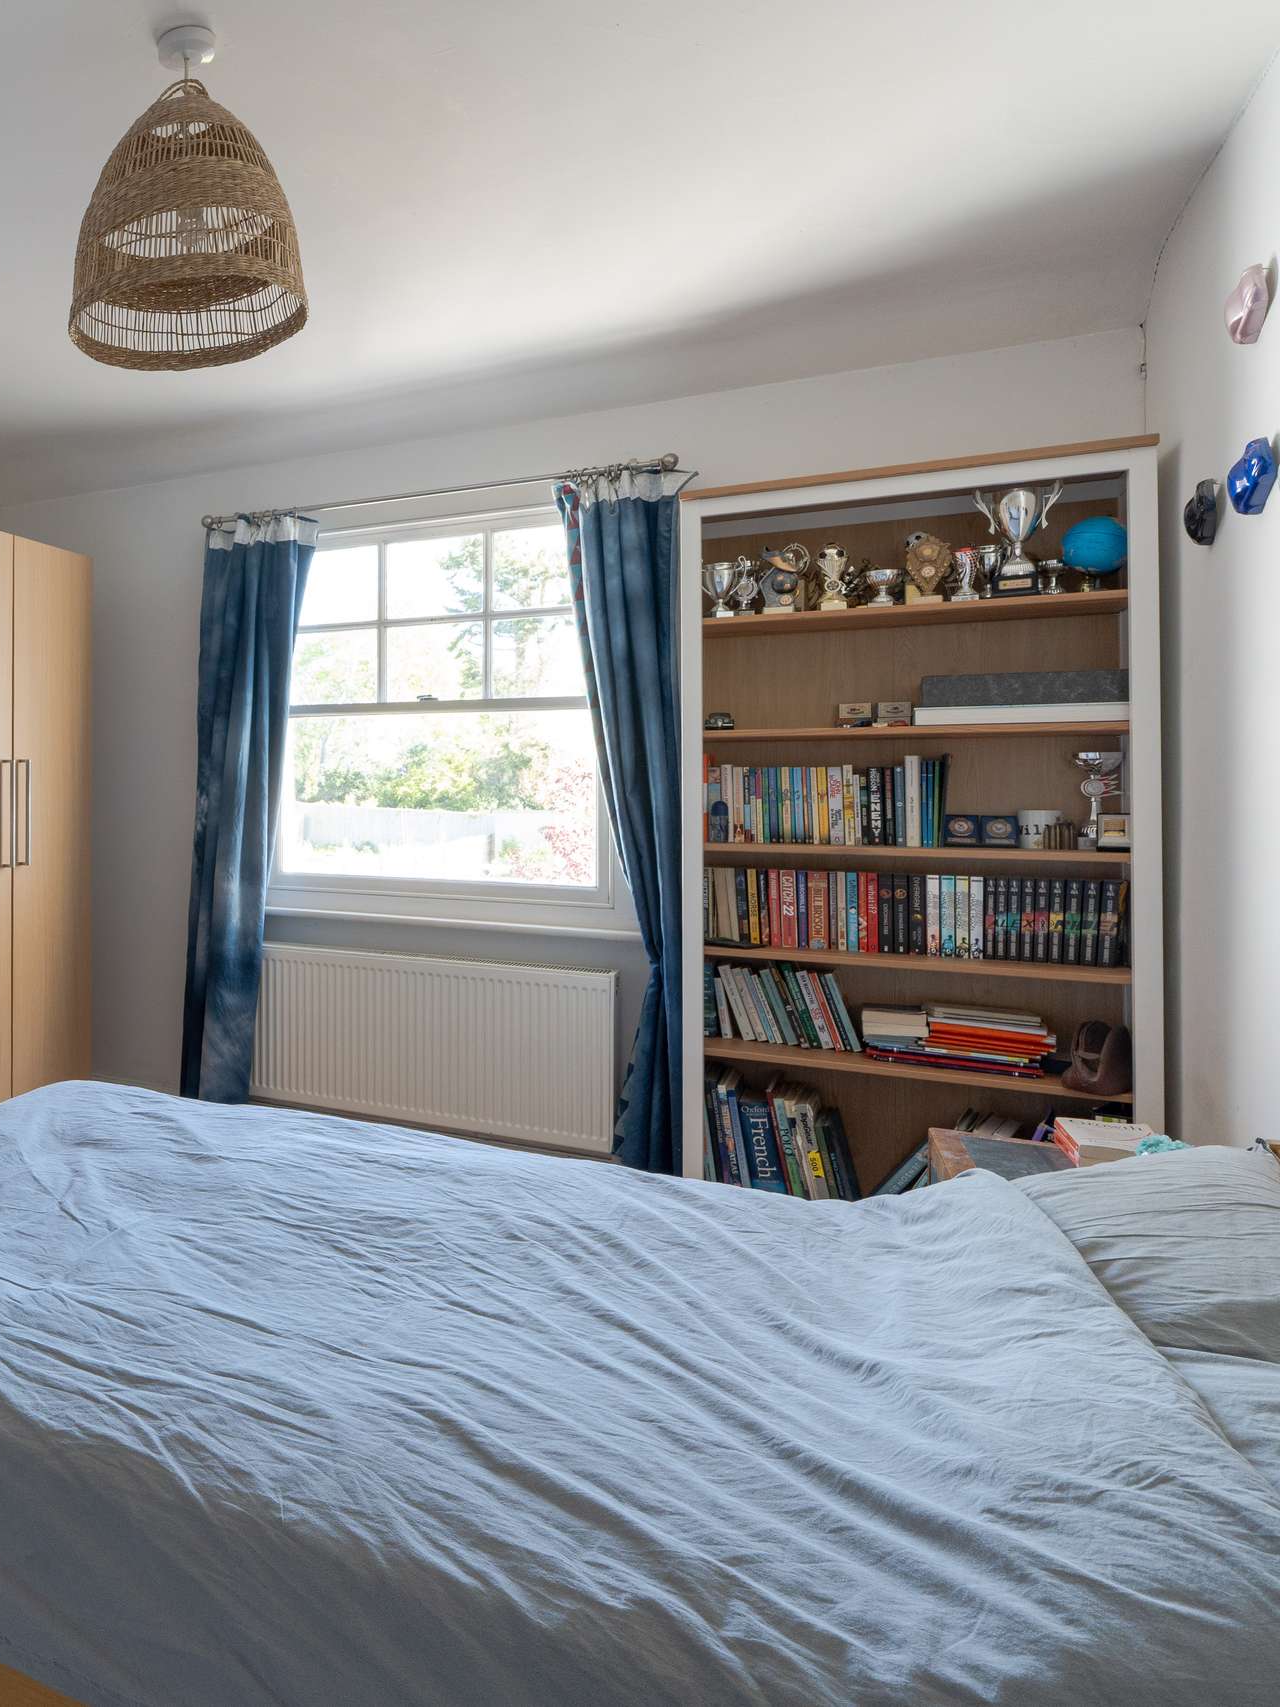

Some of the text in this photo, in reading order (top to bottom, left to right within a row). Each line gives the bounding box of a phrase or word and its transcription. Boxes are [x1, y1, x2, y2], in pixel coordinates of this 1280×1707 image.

[870, 794, 882, 837] ENEMY
[783, 876, 794, 916] CATCH-22
[867, 885, 876, 903] what
[912, 877, 920, 911] DIVERGENT
[813, 905, 824, 937] BRYSON
[749, 1118, 777, 1178] French
[809, 1157, 819, 1172] 500
